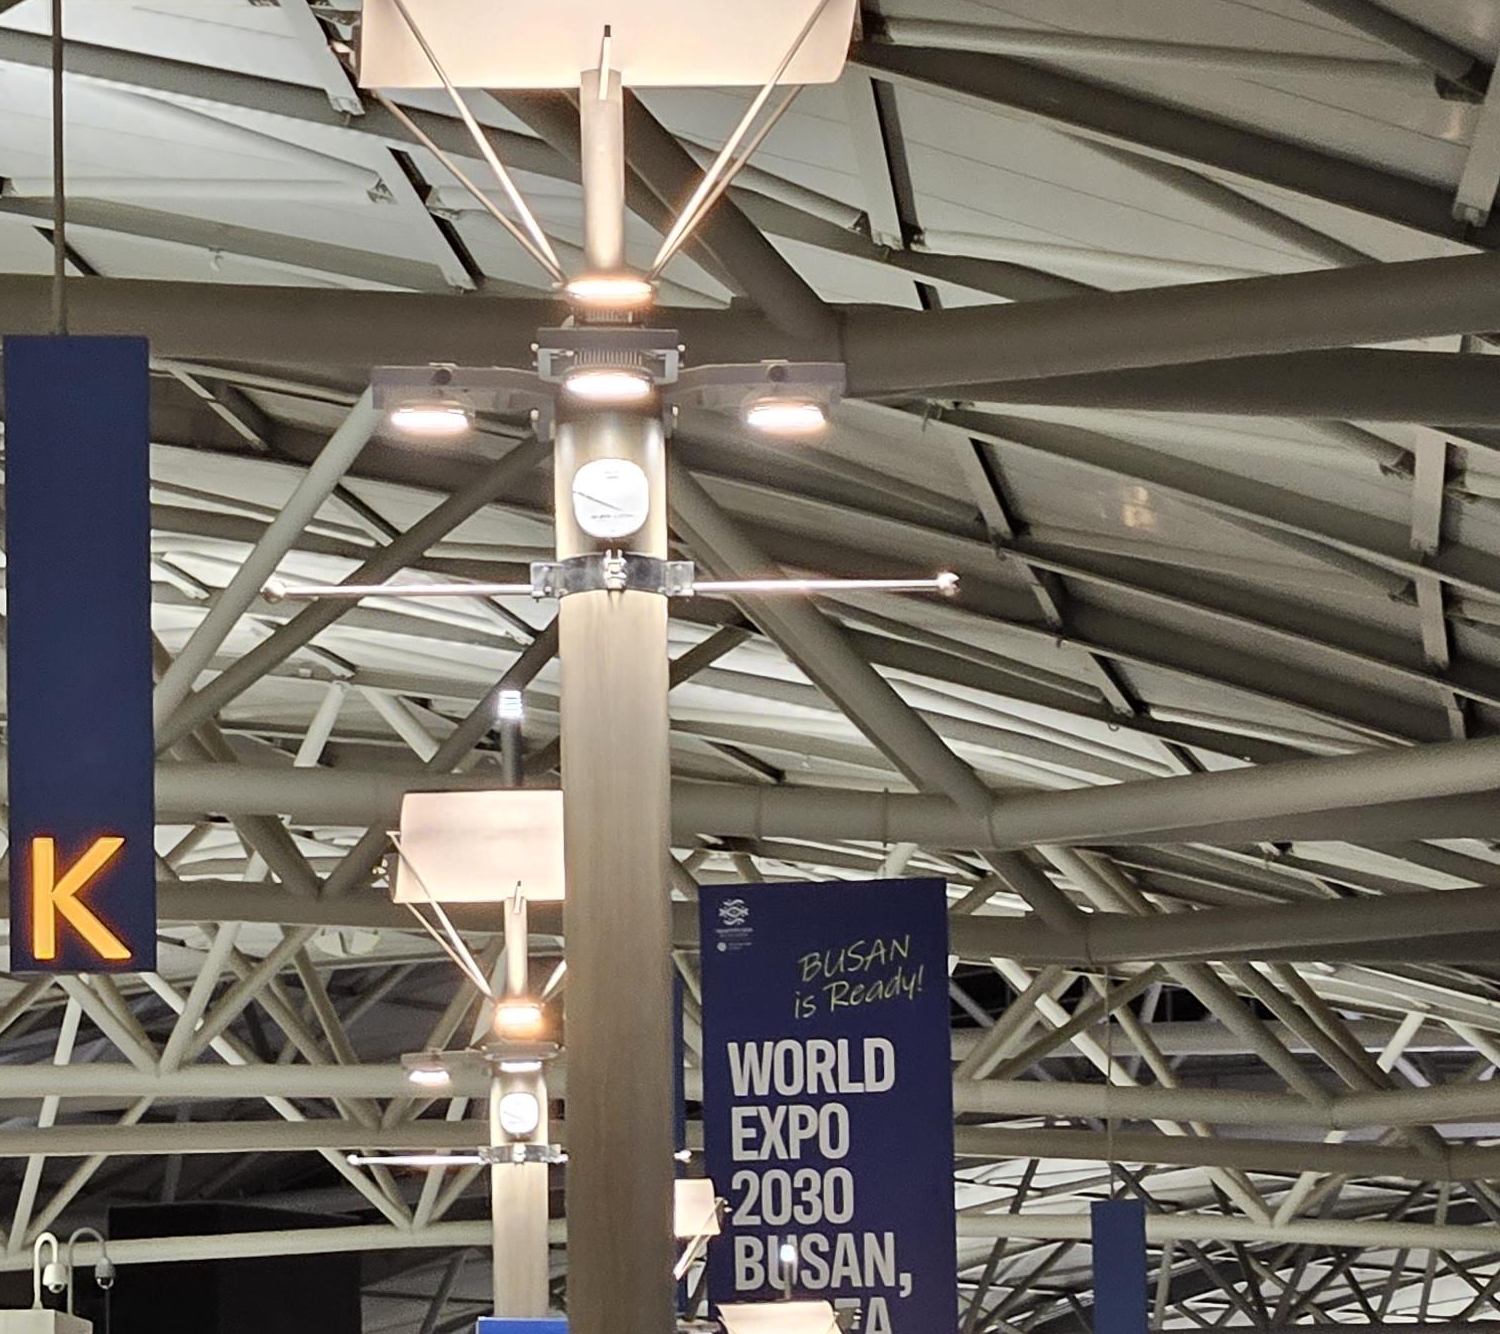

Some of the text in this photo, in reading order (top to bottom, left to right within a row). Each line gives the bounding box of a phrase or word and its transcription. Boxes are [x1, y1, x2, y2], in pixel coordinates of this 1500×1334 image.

[32, 836, 133, 960] K
[798, 934, 911, 982] BUSAN
[794, 965, 924, 1019] is Ready!
[727, 1037, 896, 1097] WORLD
[731, 1102, 850, 1162] EXPO
[731, 1167, 854, 1226] 2030
[734, 1232, 912, 1298] BUSAN,
